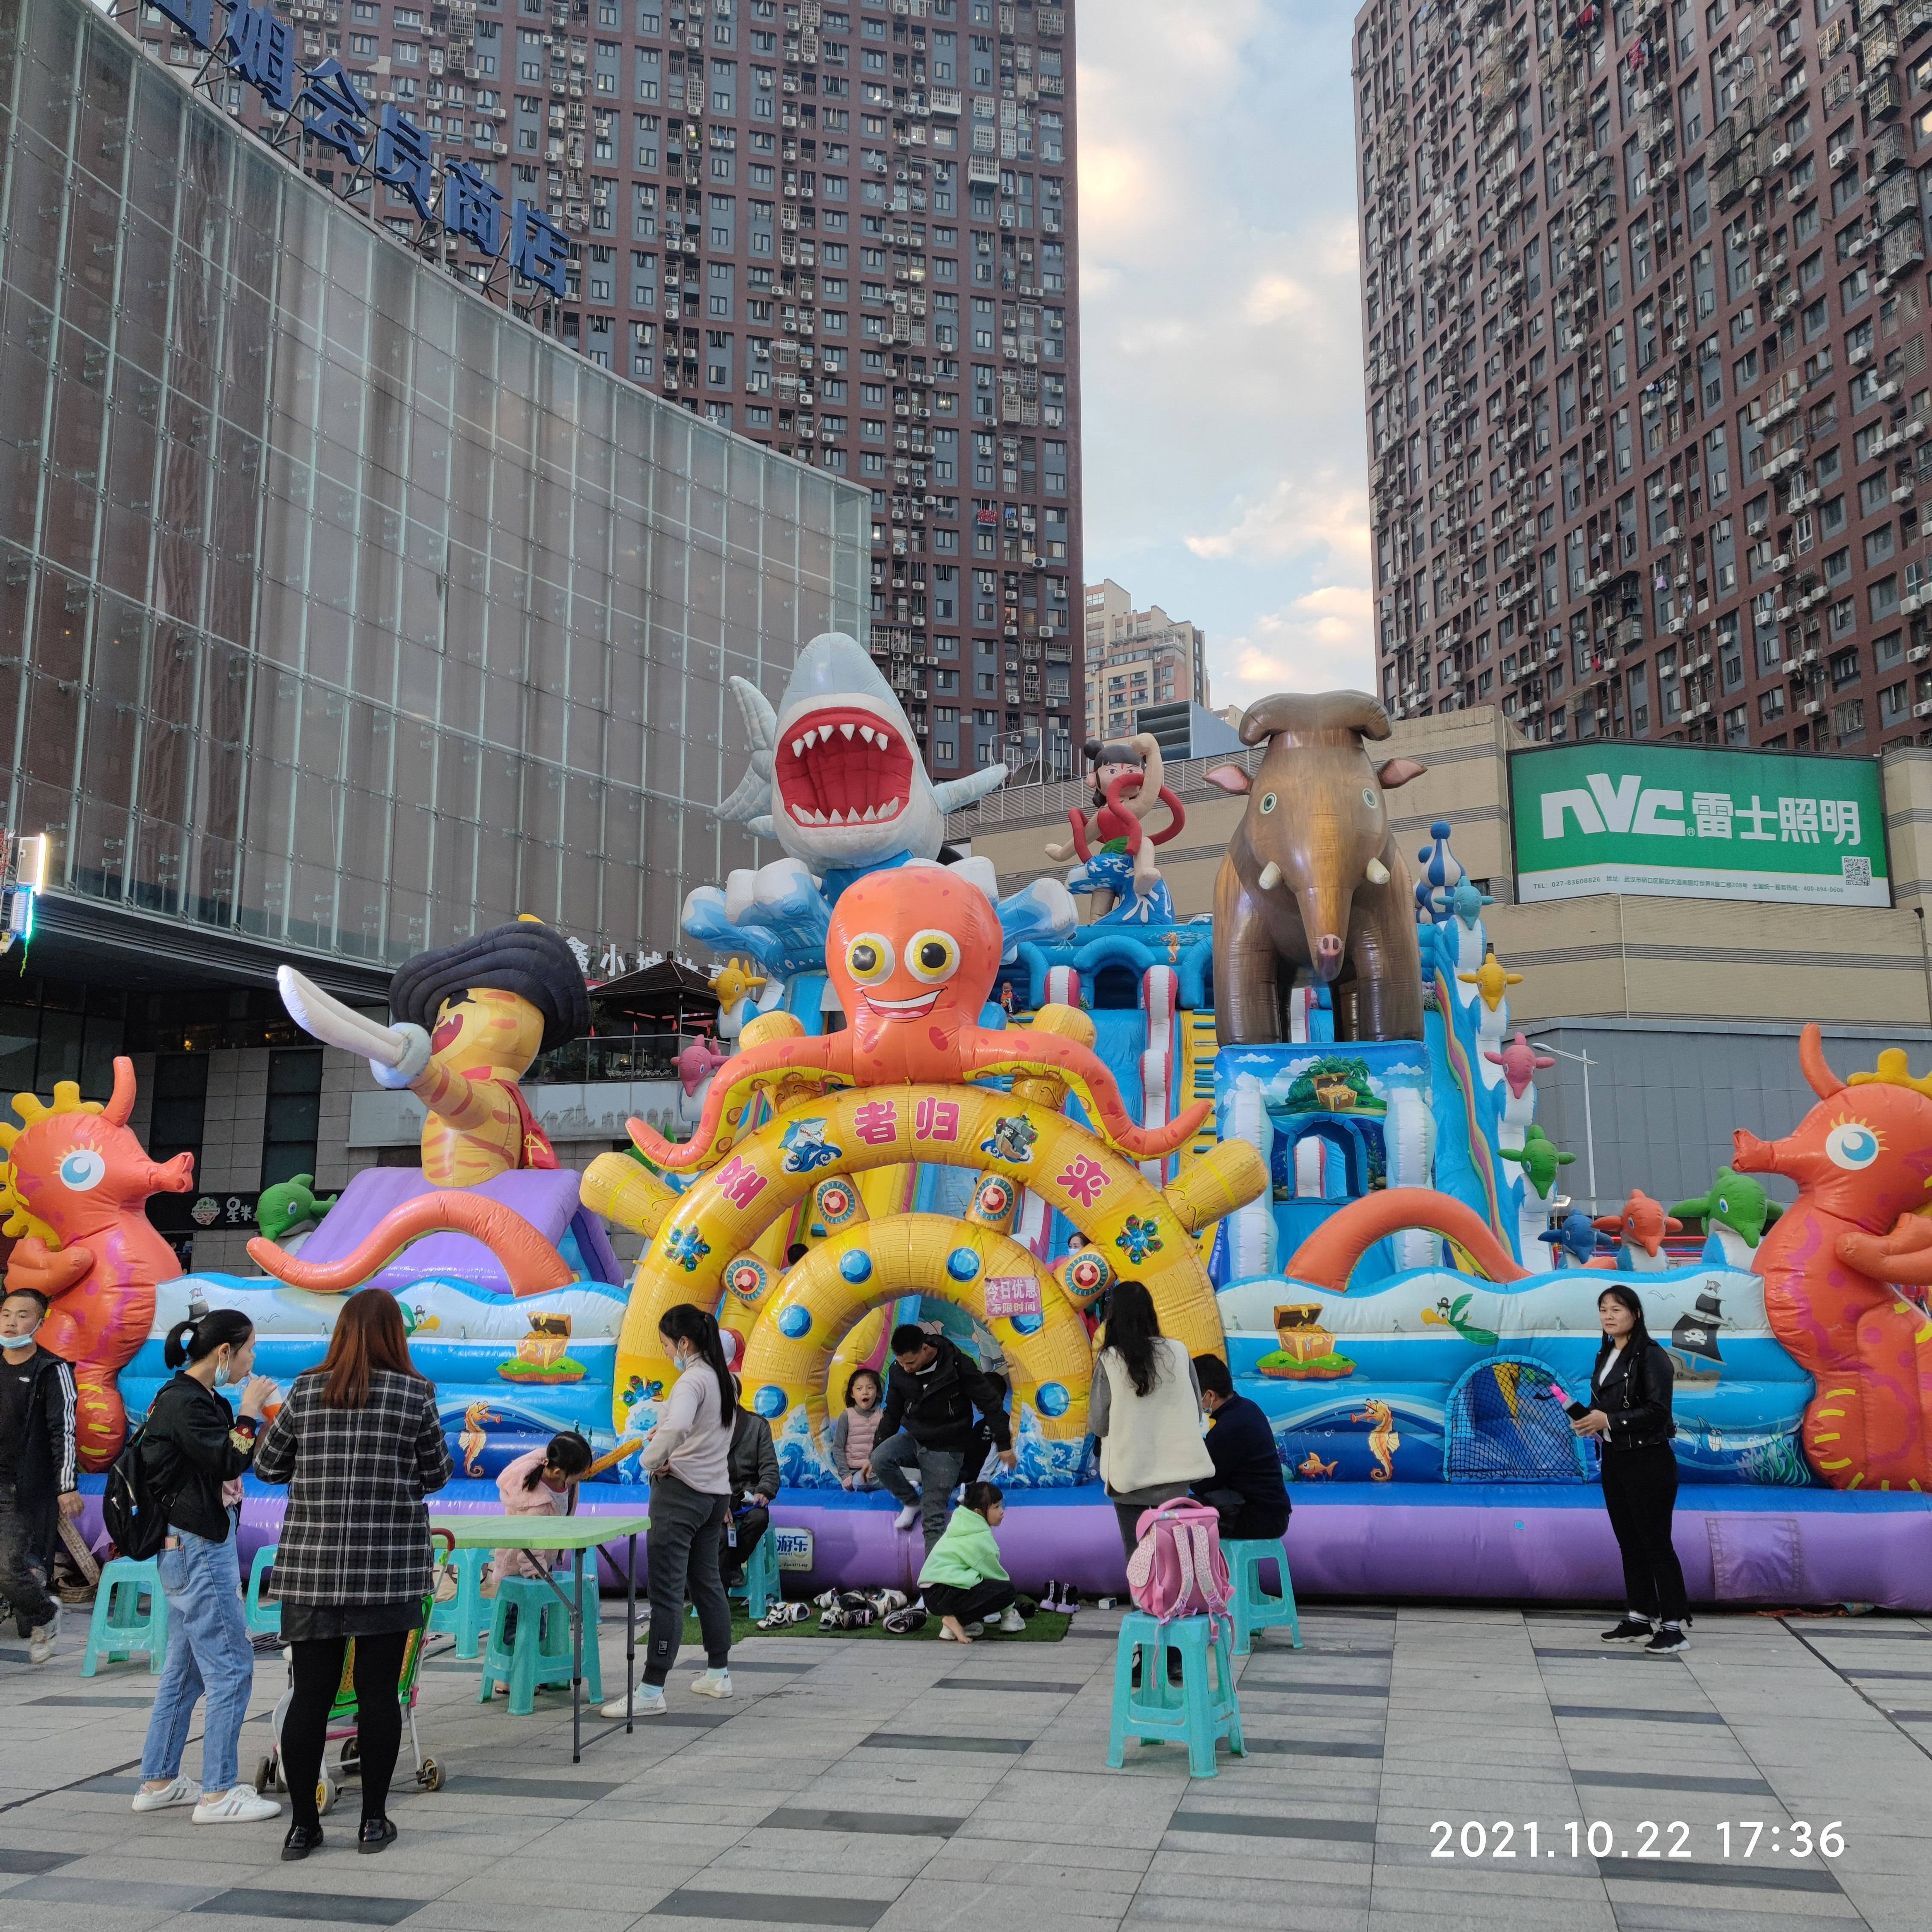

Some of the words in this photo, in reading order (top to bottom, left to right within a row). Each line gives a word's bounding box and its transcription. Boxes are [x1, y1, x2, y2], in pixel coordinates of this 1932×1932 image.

[1692, 792, 1861, 846] 雷士照明
[226, 1196, 259, 1222] 星米
[986, 1279, 1038, 1300] 今日优惠
[991, 1302, 1035, 1313] 不限时间
